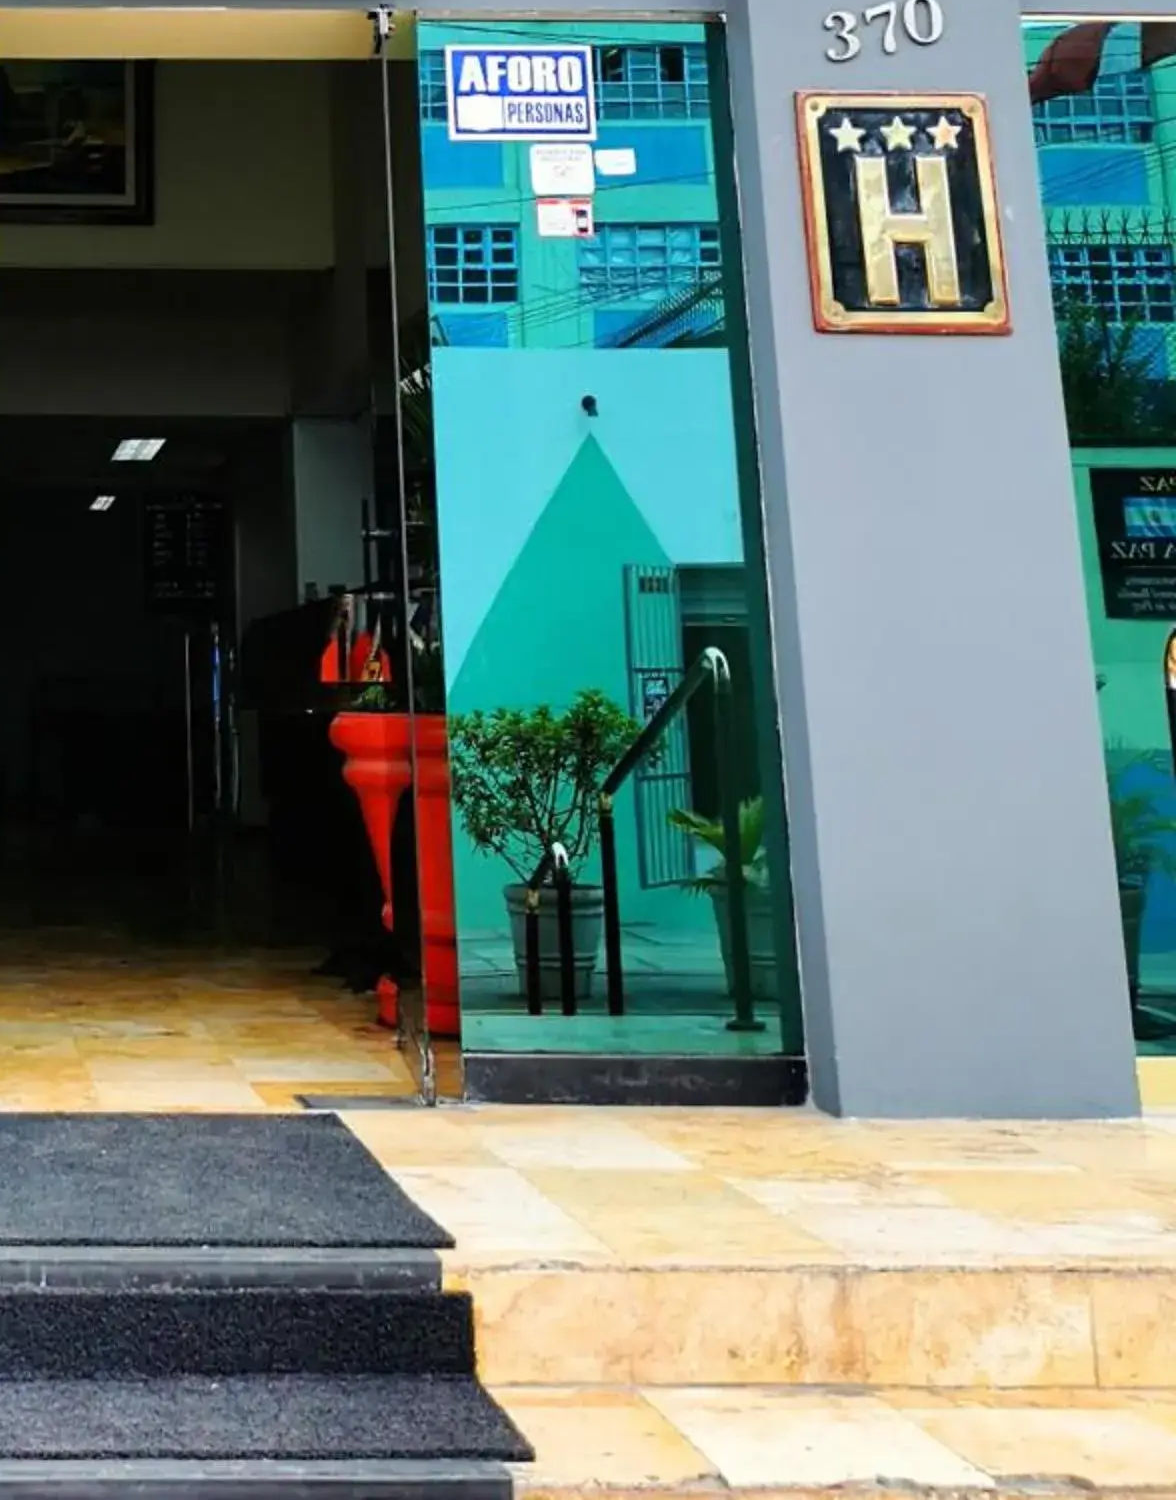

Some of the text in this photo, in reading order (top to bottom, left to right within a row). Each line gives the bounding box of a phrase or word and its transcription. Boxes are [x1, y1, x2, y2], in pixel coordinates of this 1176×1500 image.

[457, 55, 584, 93] AFORO
[506, 101, 585, 125] PERSONAS
[854, 155, 962, 307] H
